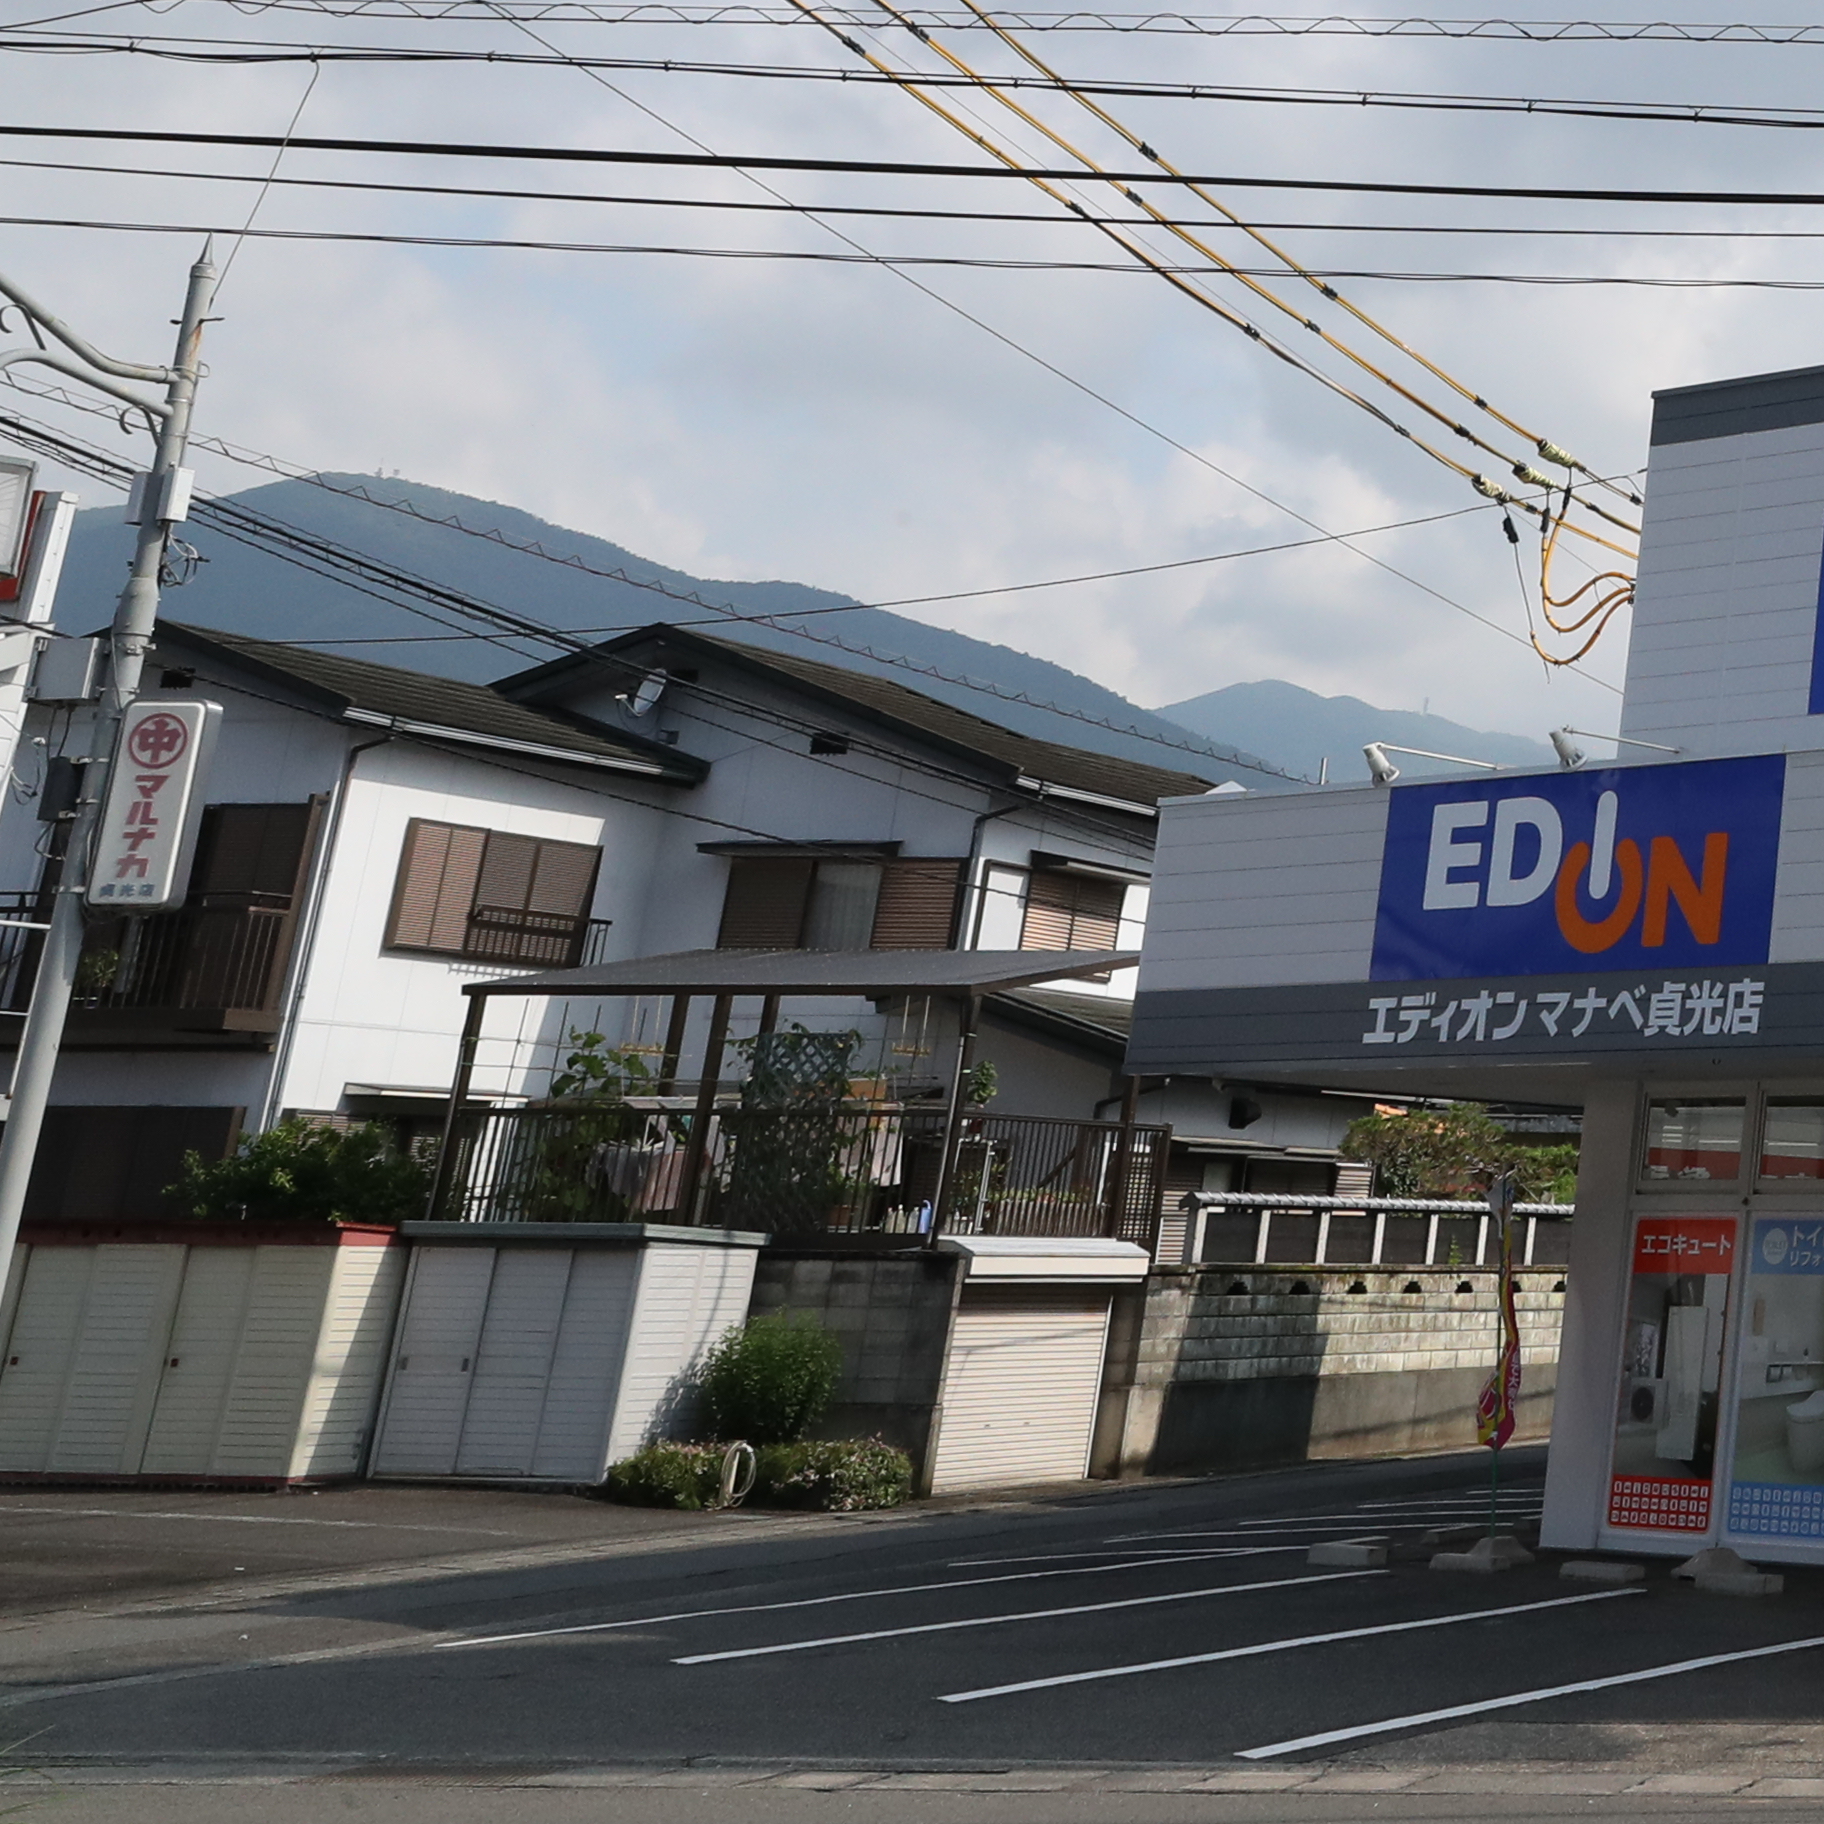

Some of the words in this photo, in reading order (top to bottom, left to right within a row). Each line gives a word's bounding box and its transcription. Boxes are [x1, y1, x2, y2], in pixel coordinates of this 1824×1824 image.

[115, 774, 171, 879] マルナカ
[1423, 790, 1729, 953] EDION
[1363, 989, 1528, 1044] エディオン
[1535, 978, 1765, 1038] マナベ貞光店
[1641, 1234, 1731, 1255] エコキュート
